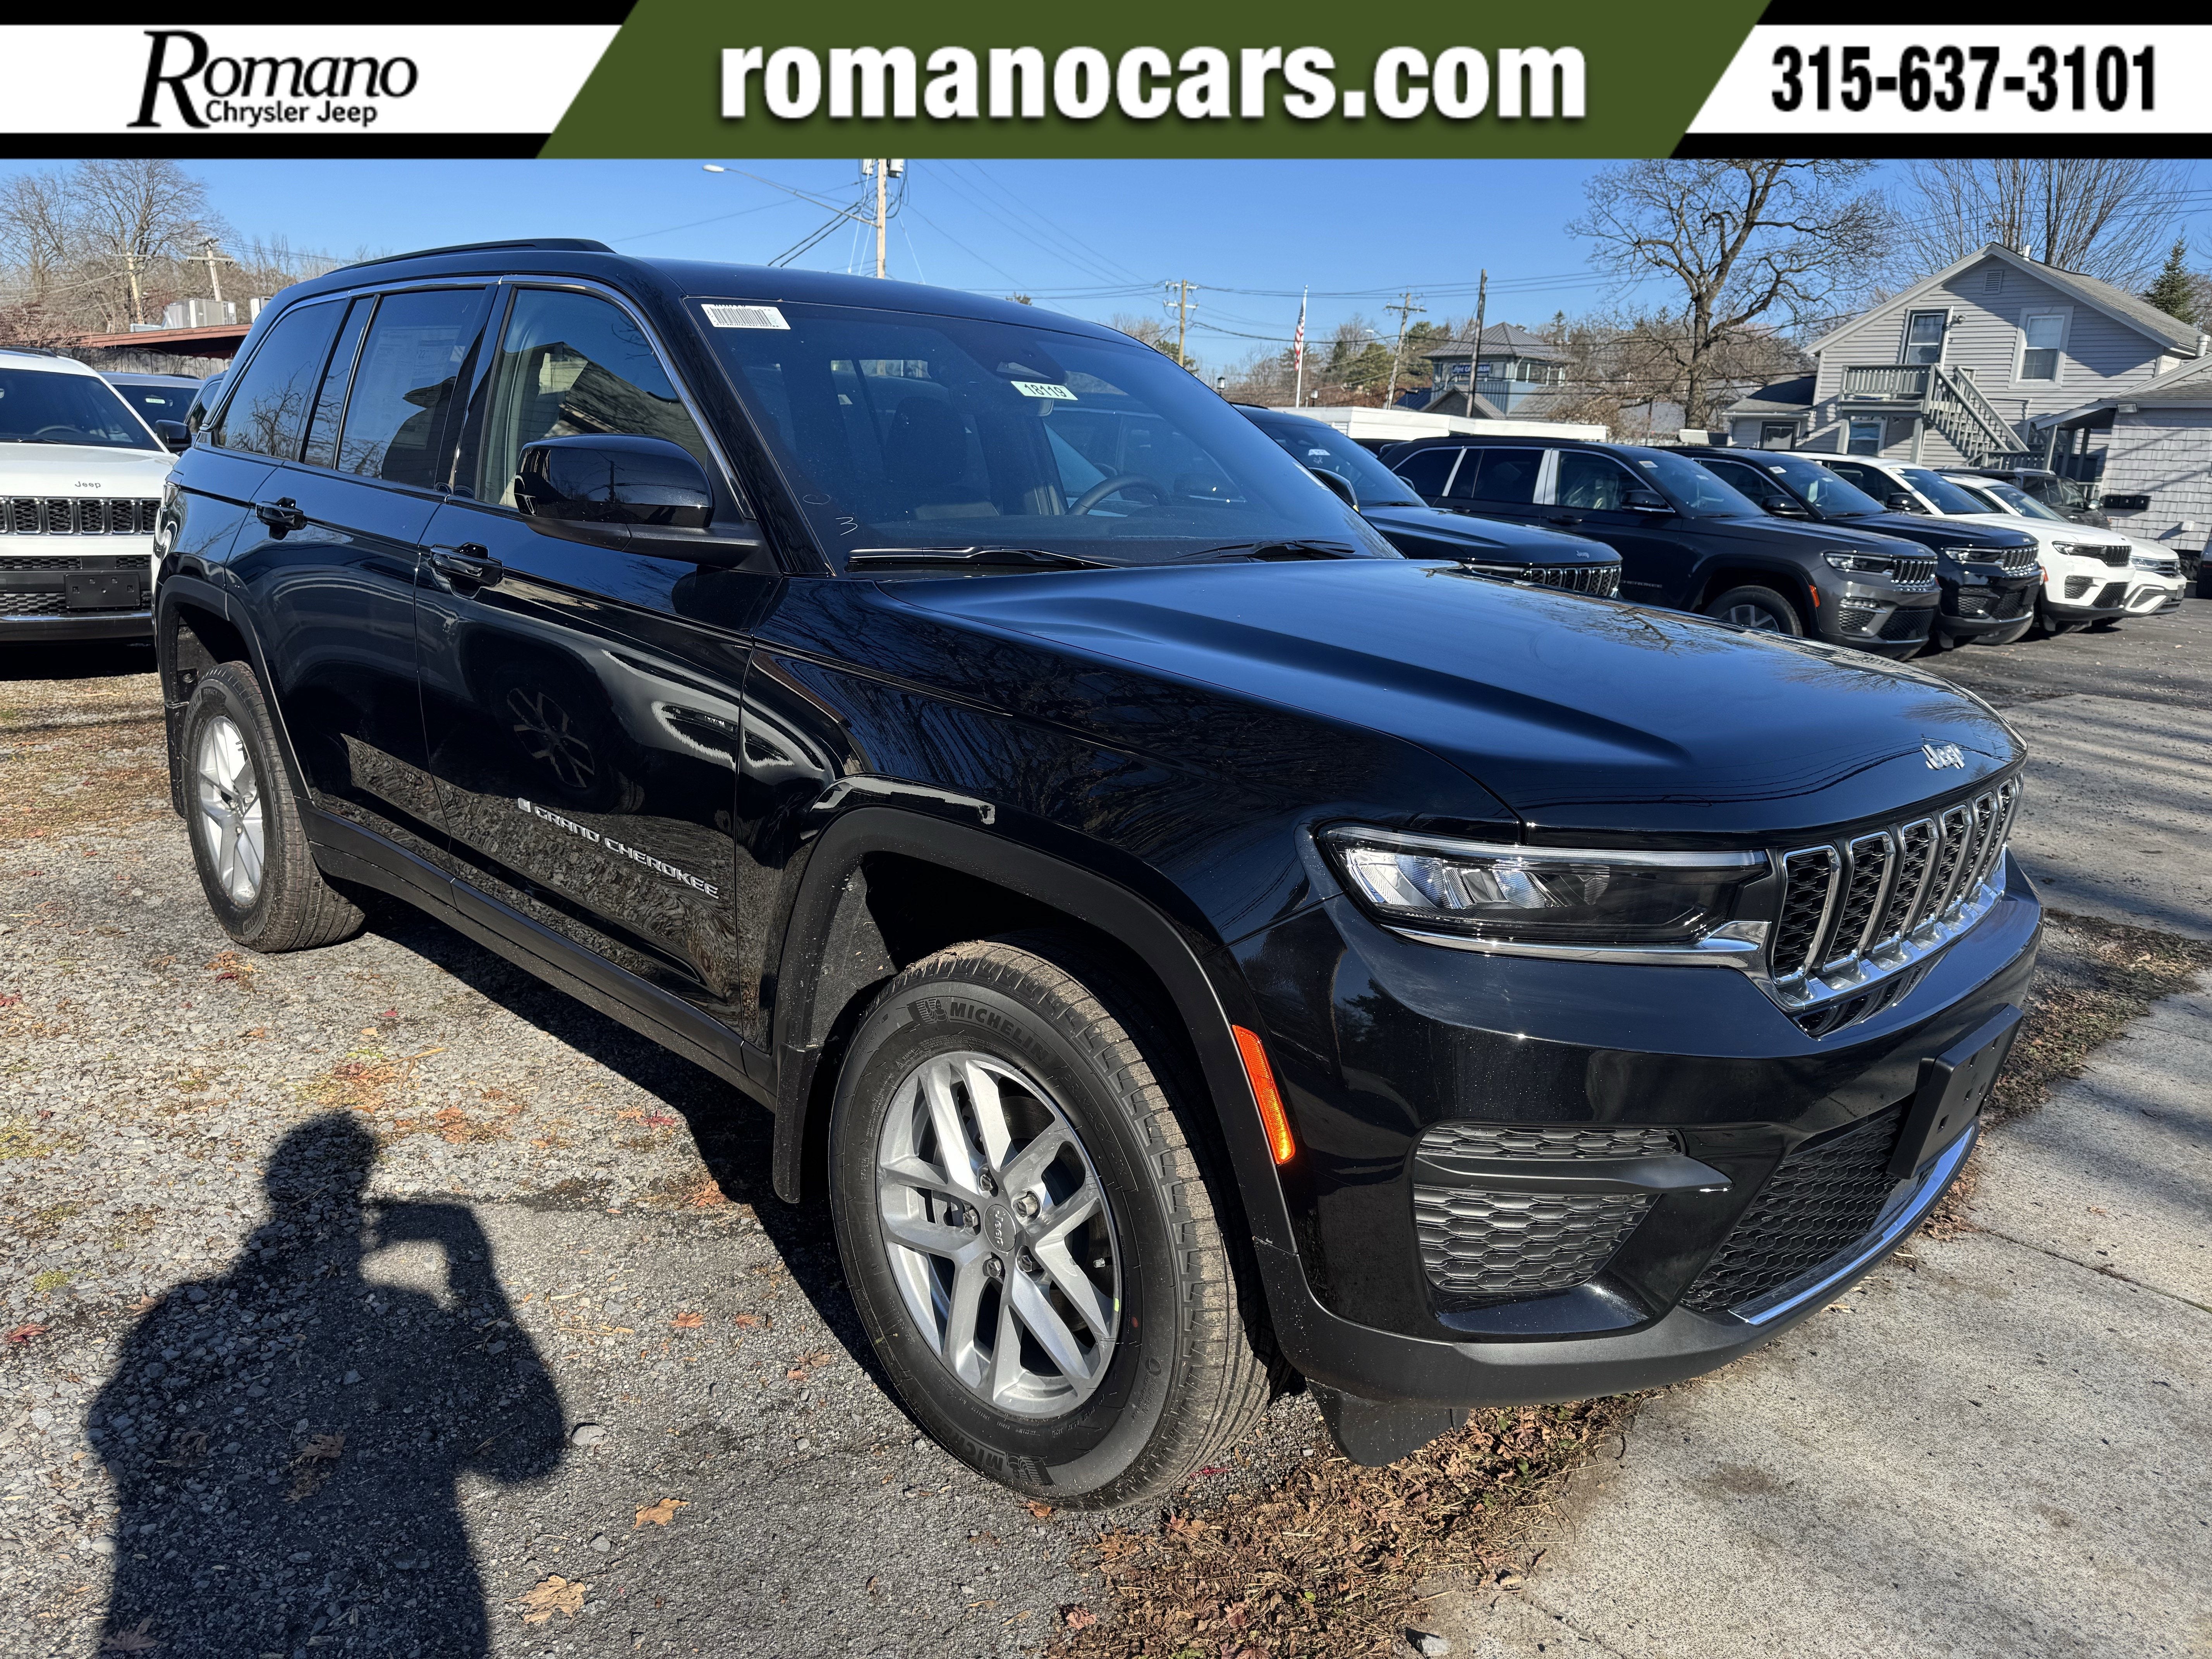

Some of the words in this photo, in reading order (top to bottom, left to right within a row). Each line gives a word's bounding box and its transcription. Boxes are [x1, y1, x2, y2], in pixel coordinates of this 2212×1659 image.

[1024, 384, 1067, 397] 18119
[835, 517, 858, 536] 3
[1921, 744, 1965, 770] Jeep
[534, 806, 600, 843] GRAND
[604, 837, 719, 899] CHEROKEE
[950, 1001, 1050, 1062] MICHELIN
[994, 1210, 1004, 1246] Jeep
